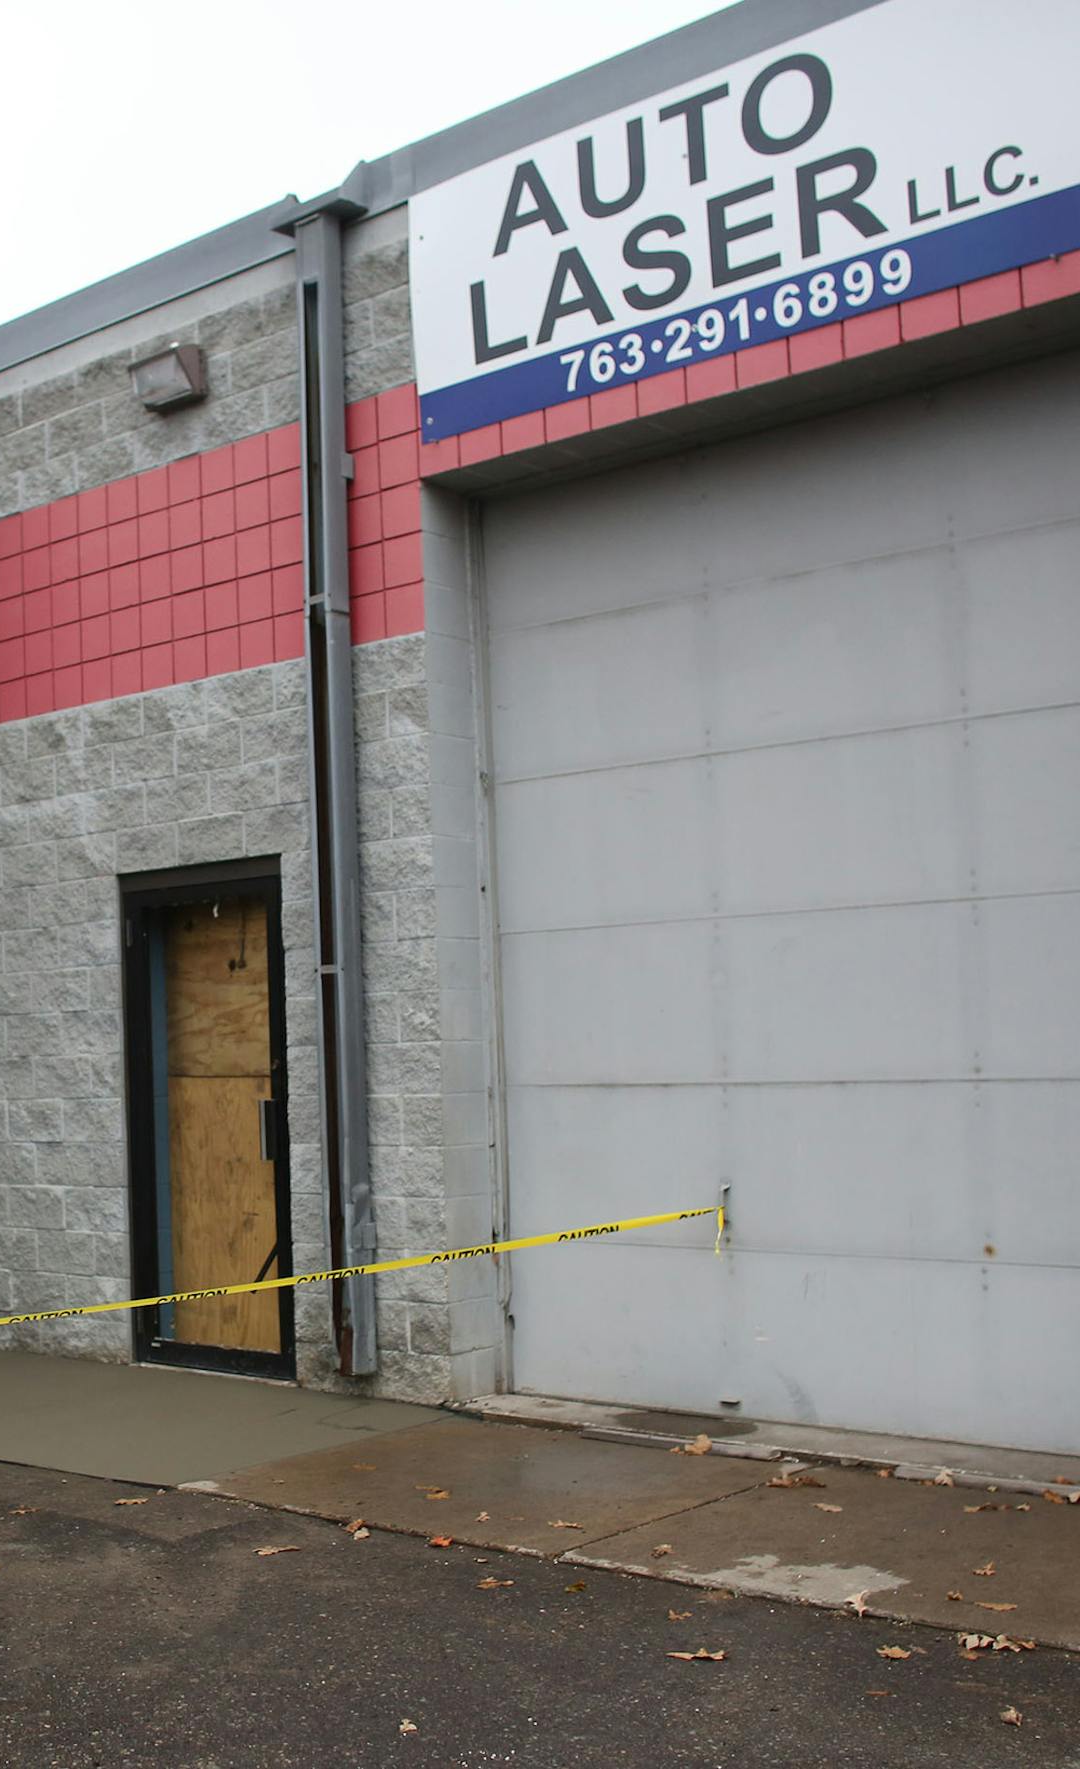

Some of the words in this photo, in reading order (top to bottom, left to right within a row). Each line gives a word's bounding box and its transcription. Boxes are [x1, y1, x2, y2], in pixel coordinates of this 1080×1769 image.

[469, 147, 889, 365] LASER
[906, 145, 1040, 225] LLC.
[493, 53, 833, 258] AUTO
